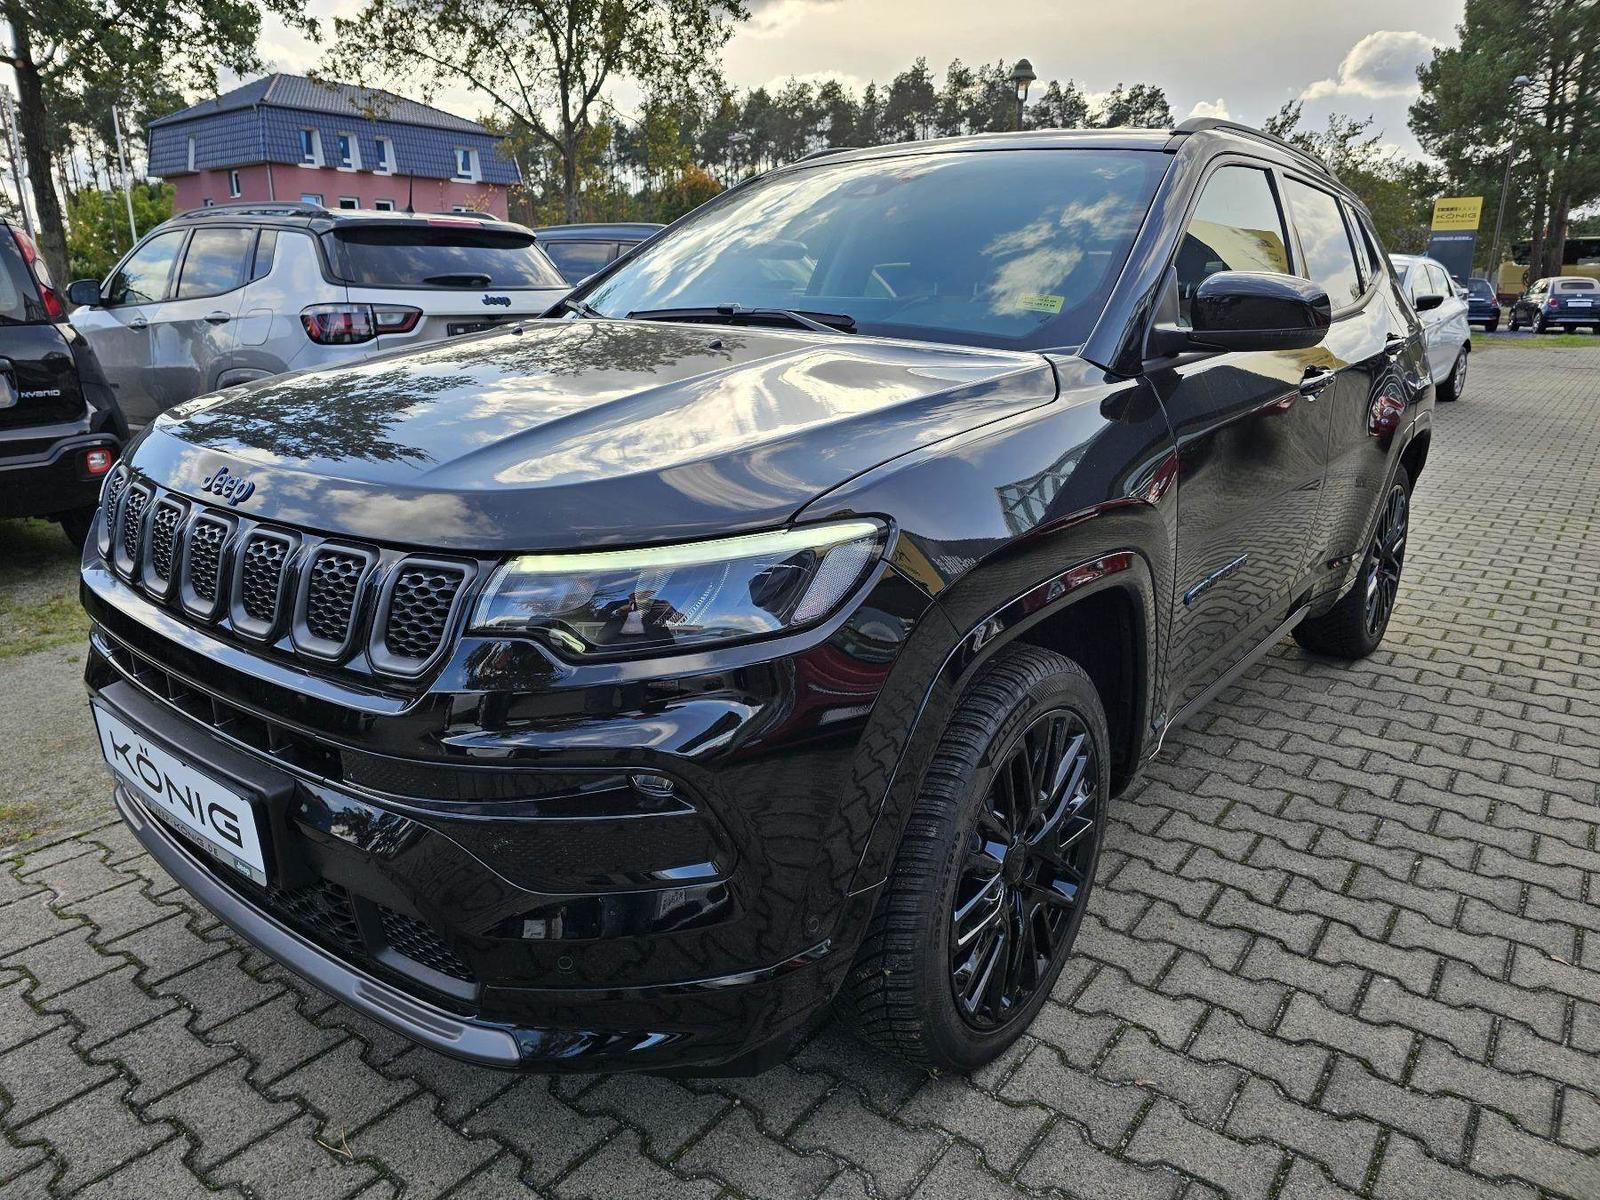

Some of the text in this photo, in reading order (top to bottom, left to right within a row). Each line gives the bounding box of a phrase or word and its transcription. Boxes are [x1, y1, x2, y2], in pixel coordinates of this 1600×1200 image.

[482, 294, 511, 307] Jeep
[21, 389, 60, 398] HYBRID
[200, 466, 256, 507] Jeep
[109, 730, 243, 848] KÖNIG
